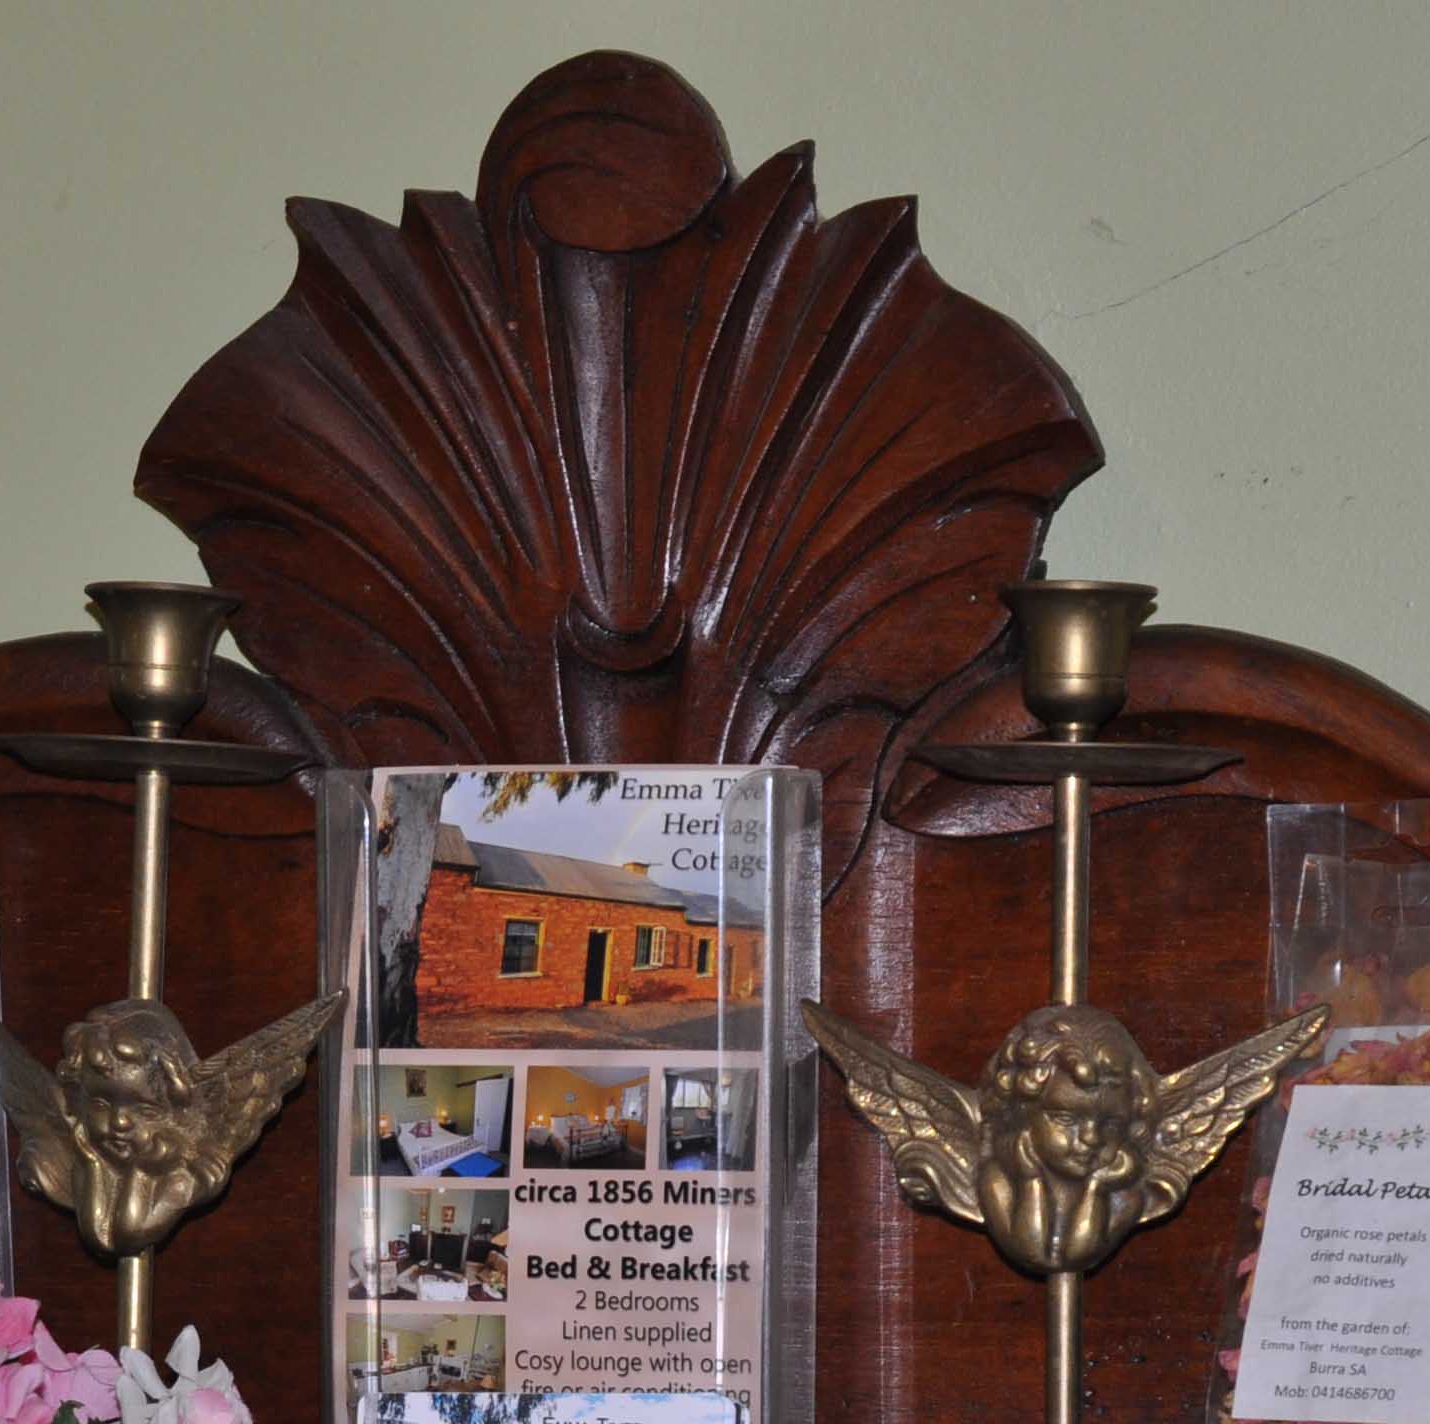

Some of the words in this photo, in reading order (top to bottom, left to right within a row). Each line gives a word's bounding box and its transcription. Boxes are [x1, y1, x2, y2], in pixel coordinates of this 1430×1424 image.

[621, 778, 702, 800] Emma
[672, 847, 767, 879] Cotage
[514, 1178, 577, 1202] circa
[588, 1180, 653, 1204] 1856
[664, 1181, 755, 1206] Miners
[1297, 1178, 1379, 1197] Bridal
[584, 1218, 694, 1249] Cottage
[1300, 1226, 1350, 1241] Organic
[1353, 1229, 1384, 1241] rose
[1386, 1228, 1427, 1243] petals
[527, 1255, 577, 1280] Bed
[587, 1256, 611, 1280] &
[622, 1256, 750, 1282] Breakfast
[1310, 1250, 1345, 1262] dried
[1348, 1251, 1408, 1267] naturally
[1313, 1274, 1330, 1285] no
[1334, 1274, 1396, 1289] additives
[575, 1290, 586, 1310] 2
[595, 1290, 699, 1312] Bedrooms
[562, 1321, 616, 1341] Linen
[624, 1321, 712, 1346] supplied
[1281, 1316, 1312, 1331] from
[1316, 1318, 1339, 1332] the
[1341, 1321, 1389, 1335] garden
[1260, 1339, 1295, 1351] Emma
[1299, 1341, 1324, 1352] Tiver
[1330, 1343, 1378, 1357] Heritage
[1380, 1344, 1424, 1358] Cottage
[515, 1351, 564, 1375] Cosy
[571, 1352, 642, 1376] lounge
[650, 1352, 692, 1373] with
[1309, 1361, 1346, 1375] Burra
[1349, 1363, 1367, 1376] SA
[1274, 1384, 1309, 1399] Mob:
